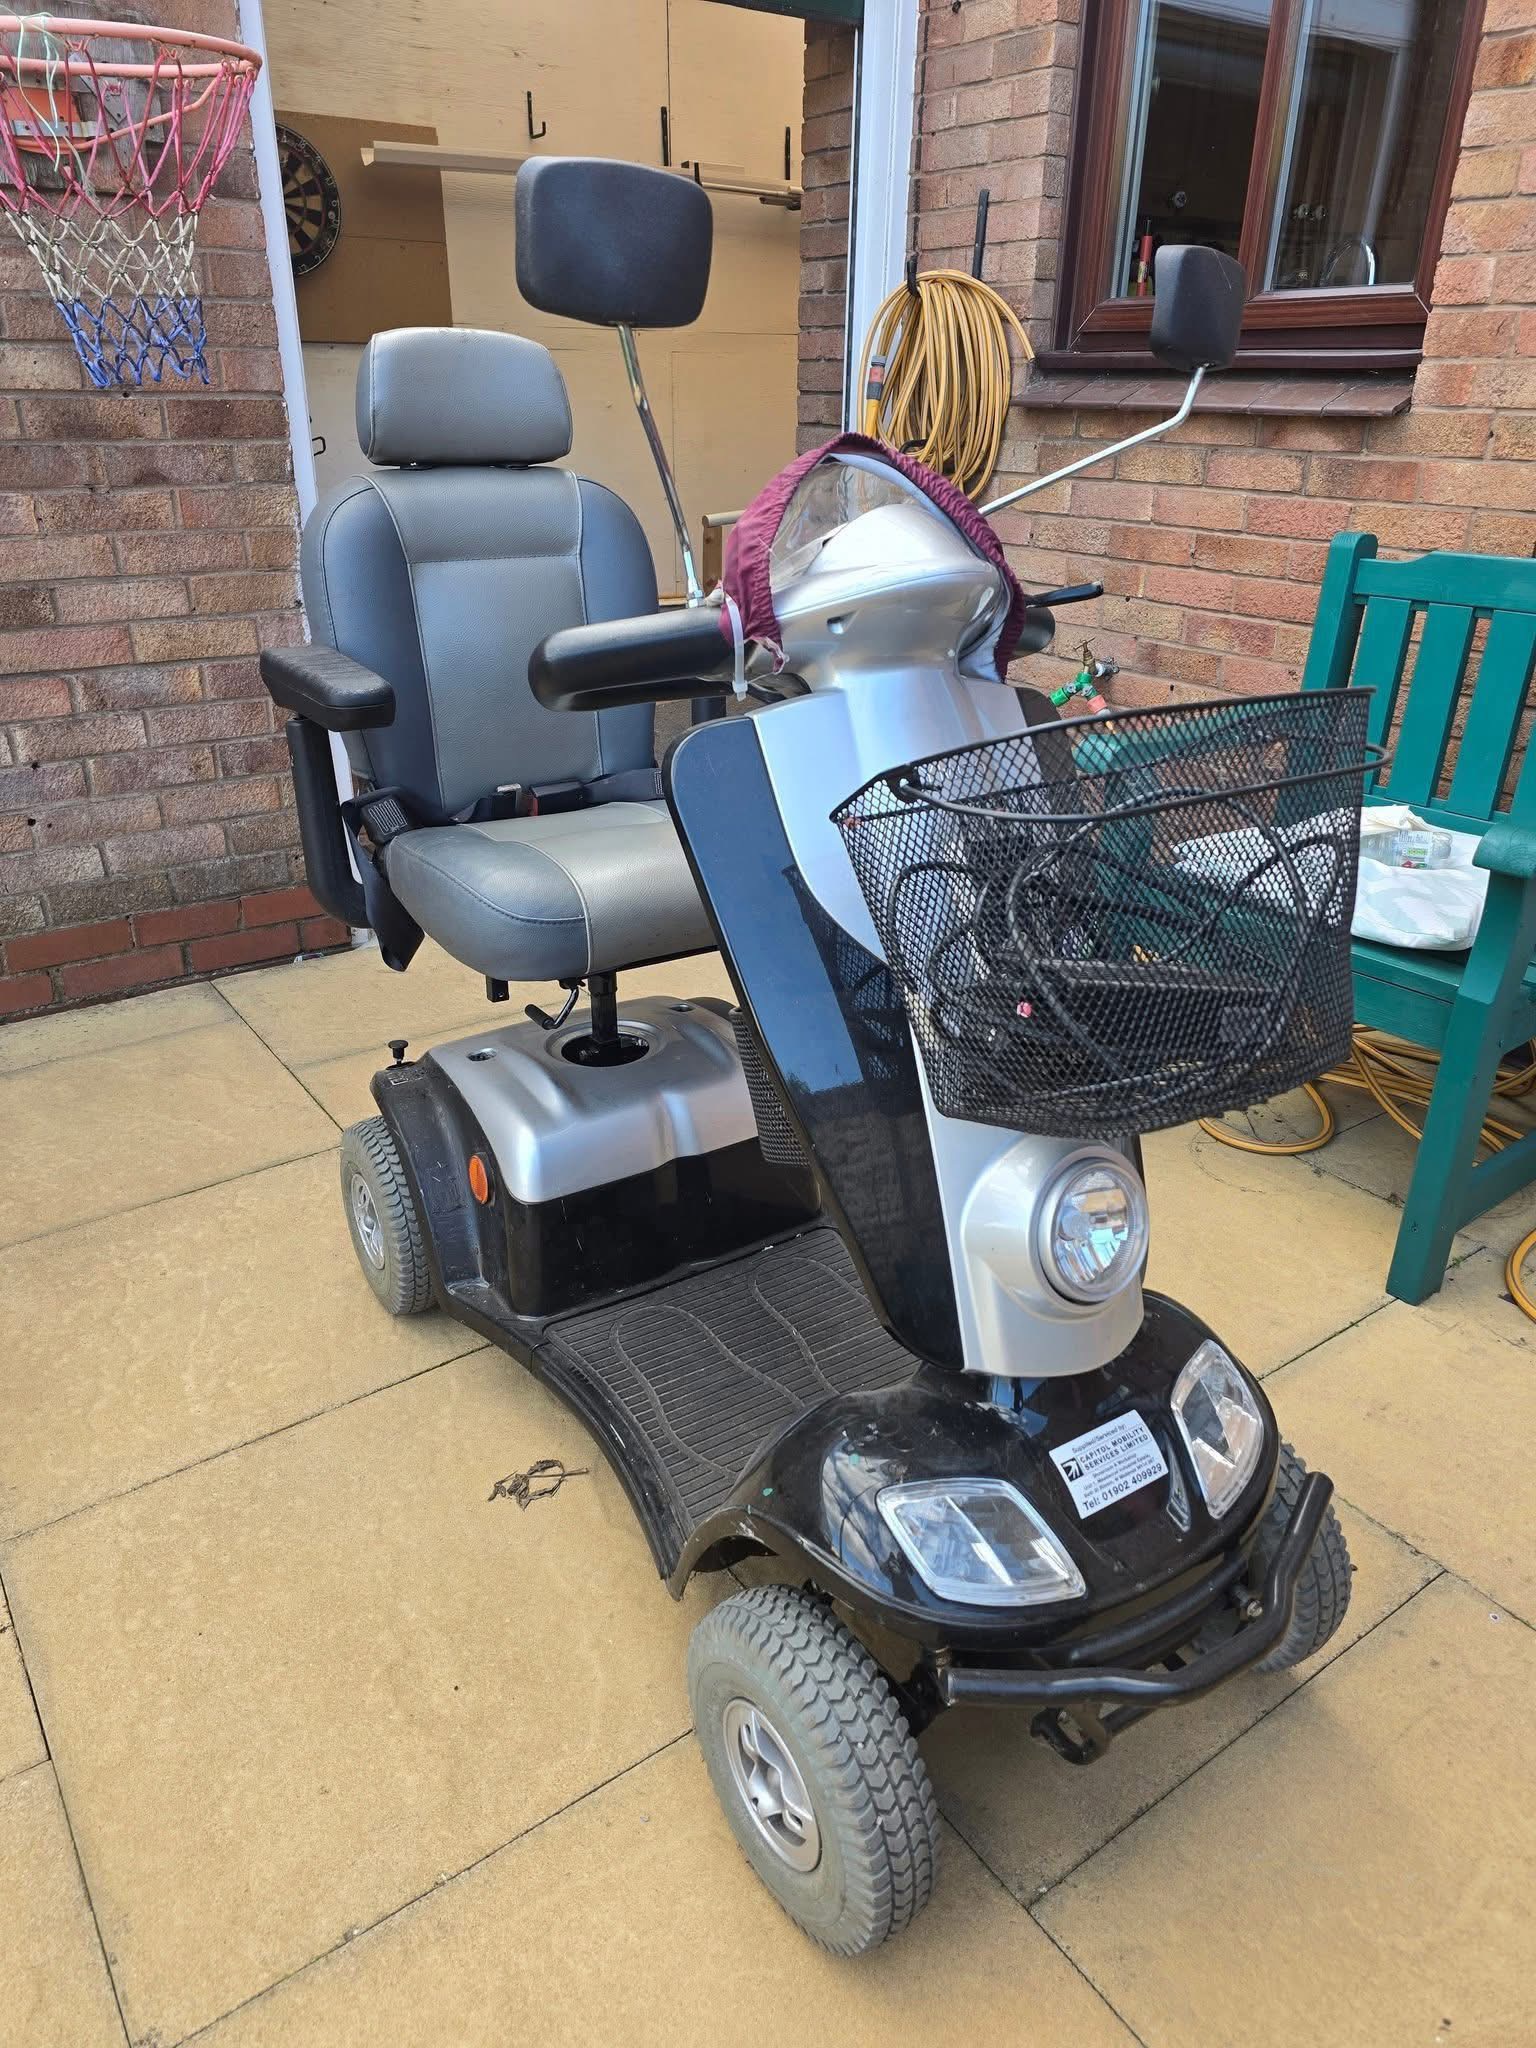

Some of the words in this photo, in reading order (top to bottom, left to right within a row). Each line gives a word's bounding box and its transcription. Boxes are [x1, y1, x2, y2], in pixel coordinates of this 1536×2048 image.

[1080, 1444, 1110, 1463] CAPITOL
[1111, 1427, 1144, 1447] MOBILITY
[1084, 1449, 1119, 1470] SERVICES
[1119, 1434, 1149, 1452] LIMITED
[1083, 1497, 1100, 1511] Tel:
[1102, 1481, 1130, 1501] 01902
[1131, 1463, 1163, 1485] 409929
